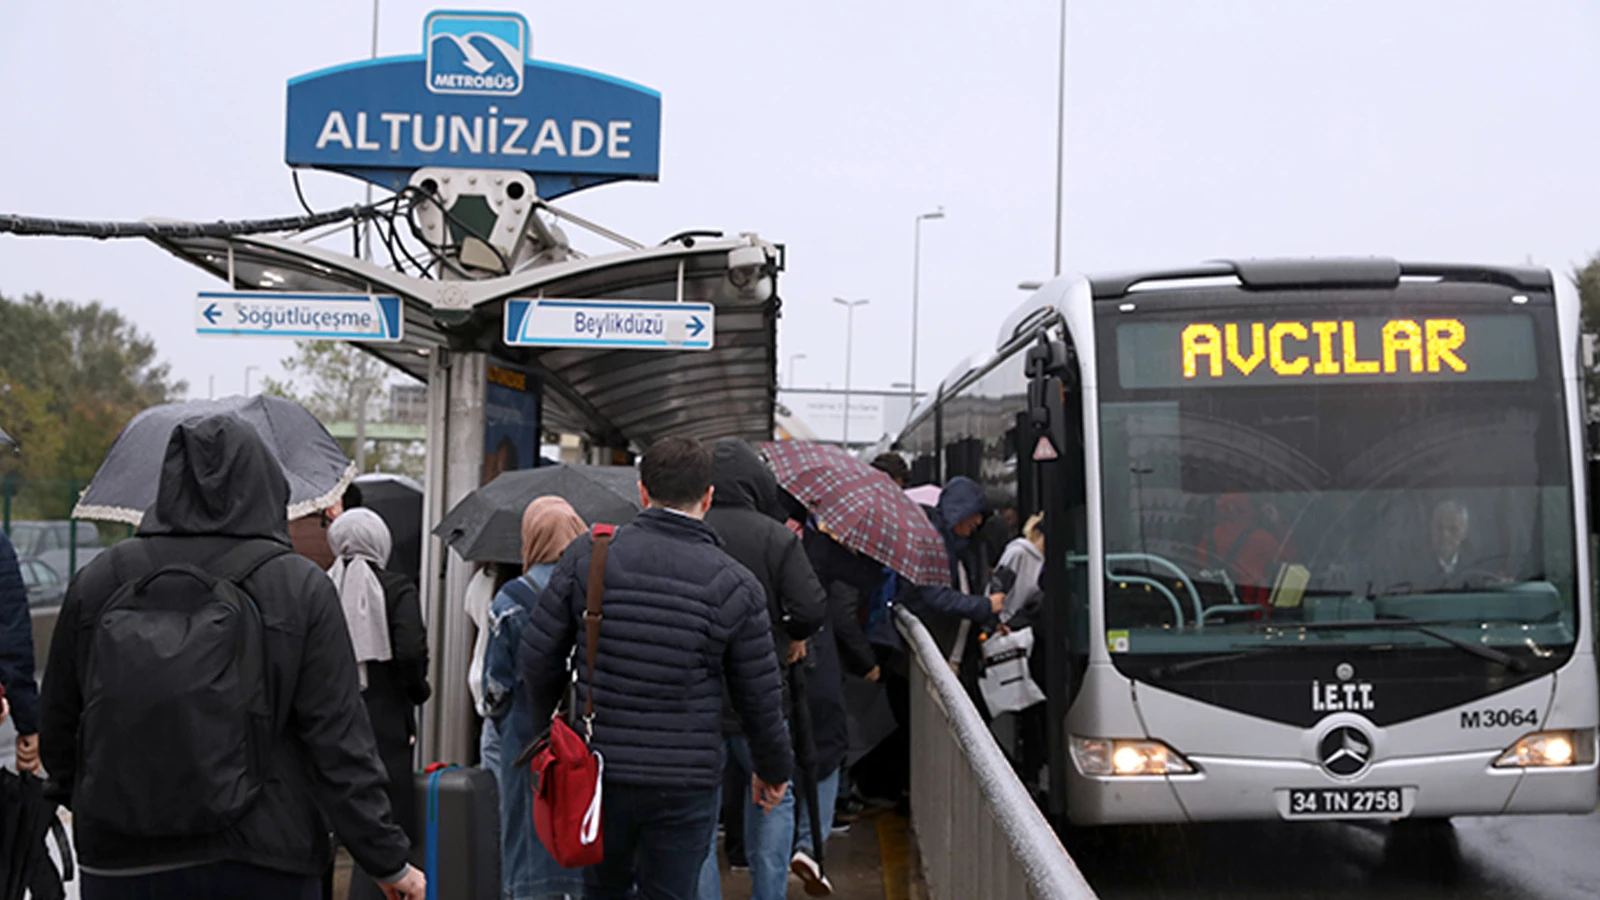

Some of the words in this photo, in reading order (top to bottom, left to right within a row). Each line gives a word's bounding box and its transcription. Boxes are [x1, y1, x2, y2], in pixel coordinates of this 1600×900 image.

[435, 73, 515, 89] METROBÜS
[315, 106, 632, 158] ALTUNİZADE
[237, 305, 372, 330] Söğütlüçeşme
[574, 311, 663, 338] Beylikdüzü
[1181, 319, 1467, 378] AVCILAR
[1460, 709, 1538, 729] M3064
[1293, 792, 1317, 811] 34
[1322, 792, 1349, 811] TN
[1353, 791, 1399, 811] 2758
